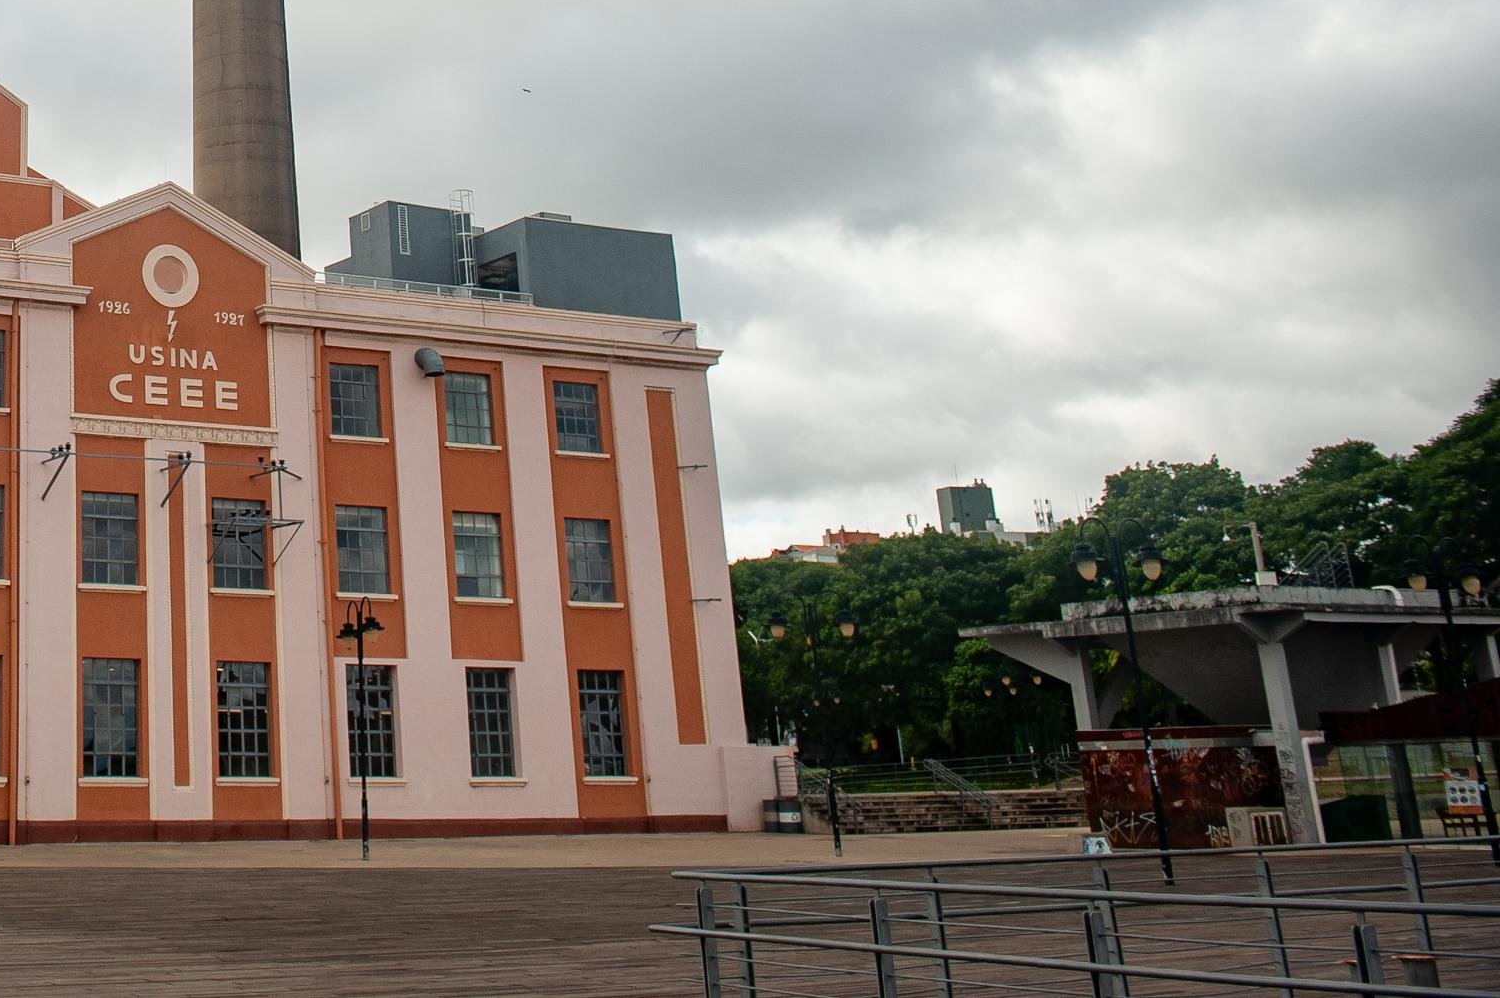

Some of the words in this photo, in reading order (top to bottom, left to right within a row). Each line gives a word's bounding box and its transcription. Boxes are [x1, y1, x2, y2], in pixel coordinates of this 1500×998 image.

[98, 300, 131, 315] 1926
[214, 311, 245, 327] 1927
[128, 344, 219, 371] USINA
[109, 373, 239, 411] CEEE
